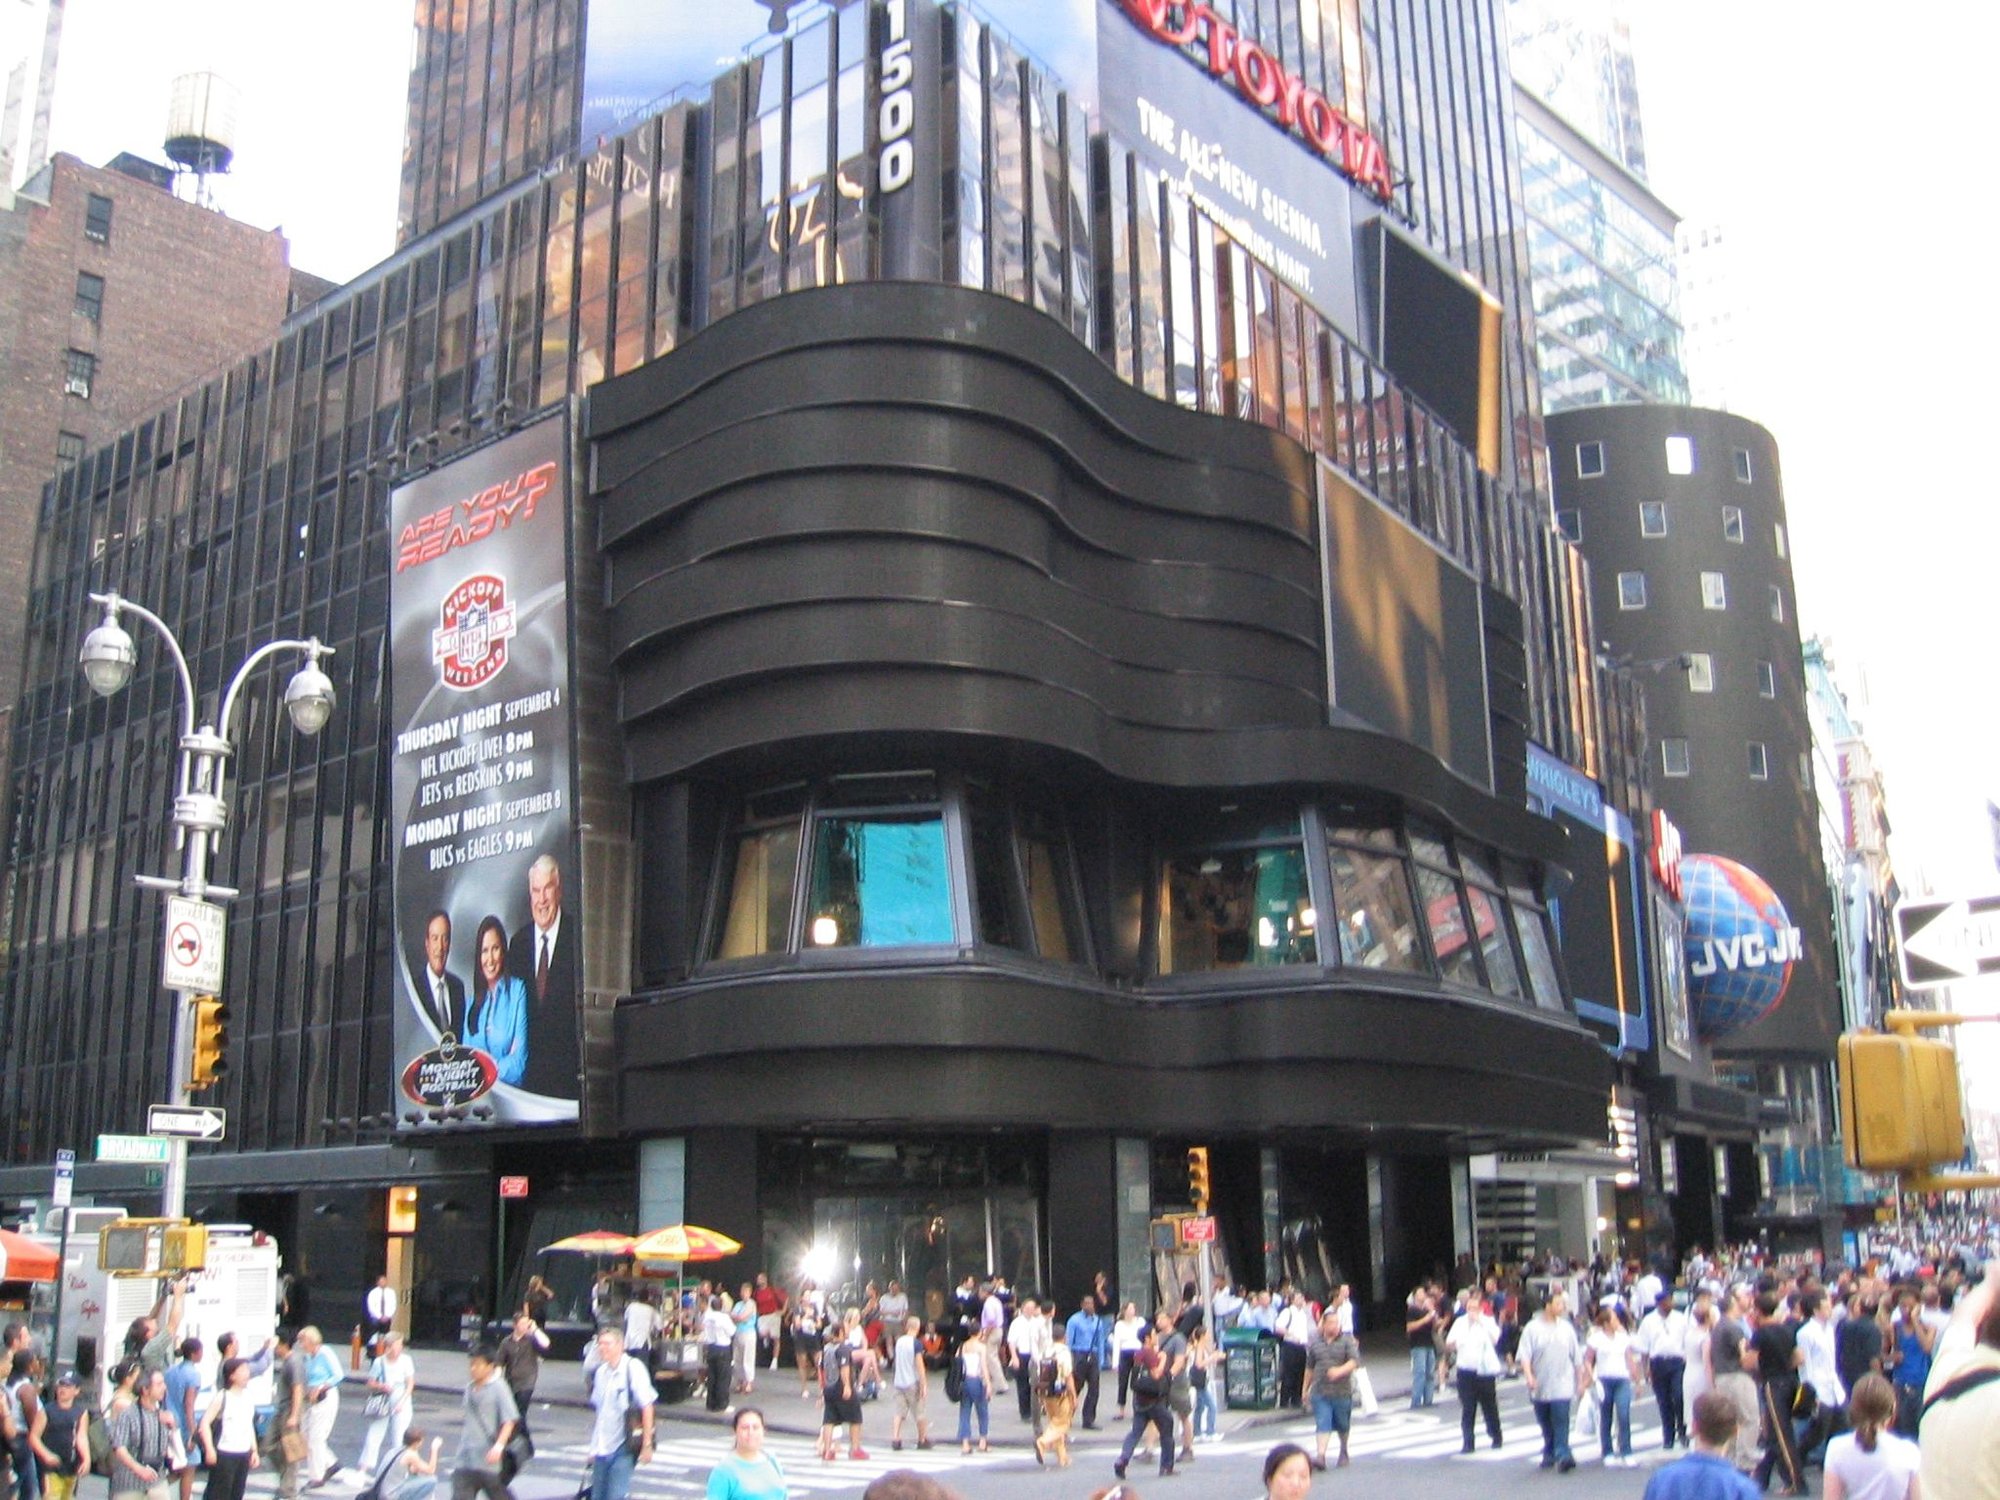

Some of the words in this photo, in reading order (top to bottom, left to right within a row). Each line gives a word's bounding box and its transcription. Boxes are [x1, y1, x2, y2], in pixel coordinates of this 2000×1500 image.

[880, 0, 914, 193] 1500
[1194, 5, 1392, 199] TOYOTA
[1137, 96, 1176, 155] THE
[399, 505, 455, 547] ARE
[461, 473, 526, 516] YOU
[446, 581, 502, 619] KICKOFF
[446, 648, 503, 684] WEEKEND
[397, 716, 459, 756] THURSDAY
[463, 702, 502, 735] NIGHT
[505, 690, 552, 722] SEPTEMBER
[553, 687, 560, 707] 4
[421, 755, 437, 780] NFL
[439, 742, 477, 774] KICKOFF
[479, 735, 503, 763] LIVE!
[421, 781, 442, 808] JETS
[443, 784, 454, 800] vs
[456, 763, 503, 797] REDSKINS
[1527, 754, 1599, 817] WRIGLEY'S
[405, 812, 459, 848] MONDAY
[463, 801, 502, 833] NIGHT
[506, 791, 552, 822] SEPTEMBER
[553, 789, 561, 809] 8
[430, 844, 454, 871] BUCS
[455, 847, 466, 864] vs
[467, 831, 503, 862] EAGLES
[1691, 932, 1766, 977] JVC
[420, 1059, 477, 1076] MONDAY
[420, 1079, 478, 1096] FOOTBALL
[435, 1067, 480, 1084] NIGHT
[160, 1115, 179, 1128] ONE
[102, 1139, 164, 1159] BROADWAY
